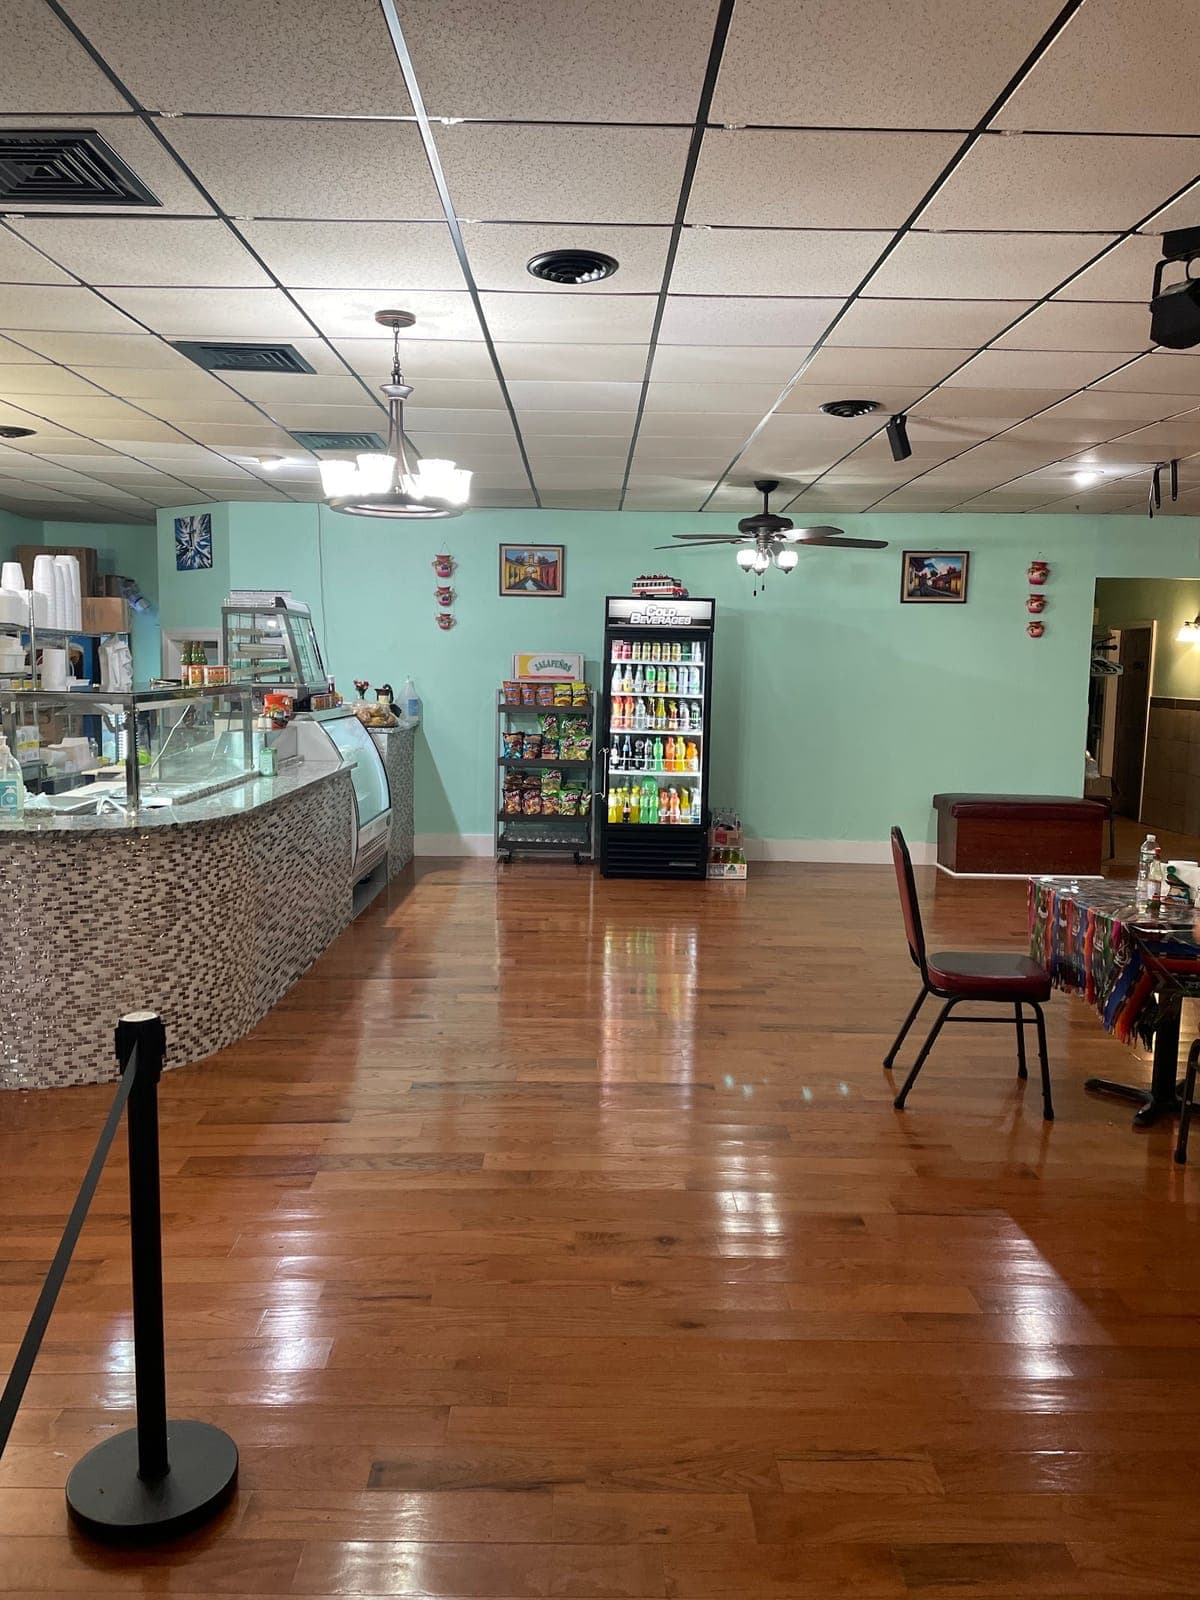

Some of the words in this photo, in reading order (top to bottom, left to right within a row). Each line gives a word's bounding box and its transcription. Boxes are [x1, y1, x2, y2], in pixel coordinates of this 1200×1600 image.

[646, 605, 677, 616] COLD
[630, 612, 692, 625] BEVERAGES
[534, 659, 573, 673] JALAPEÑOS
